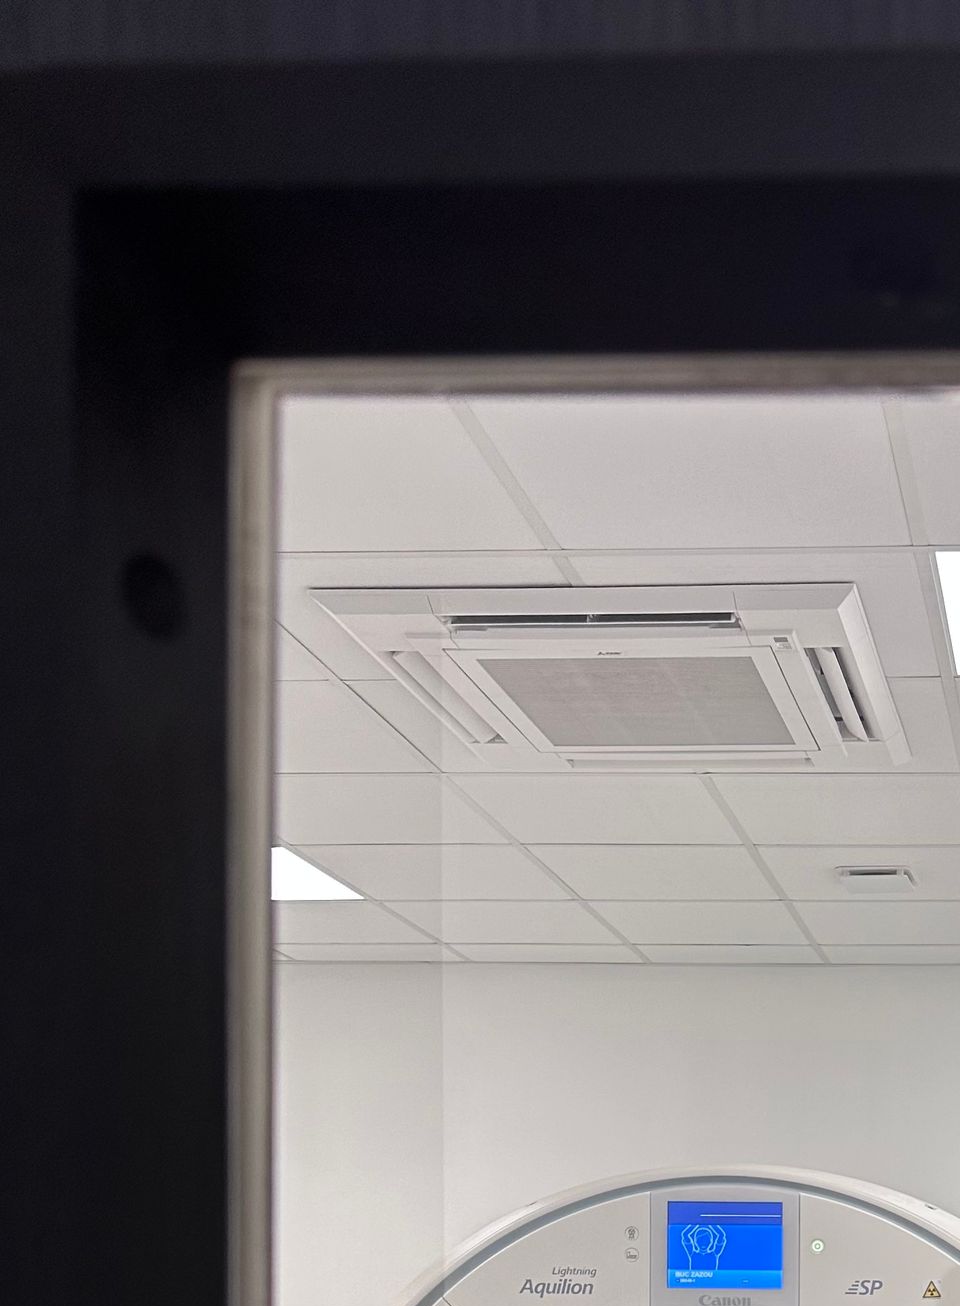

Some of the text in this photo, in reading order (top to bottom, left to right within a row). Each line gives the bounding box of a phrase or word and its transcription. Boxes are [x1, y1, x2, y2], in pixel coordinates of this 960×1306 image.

[552, 1266, 597, 1278] Lightning
[519, 1279, 594, 1298] Aquilion
[698, 1294, 752, 1306] Canon
